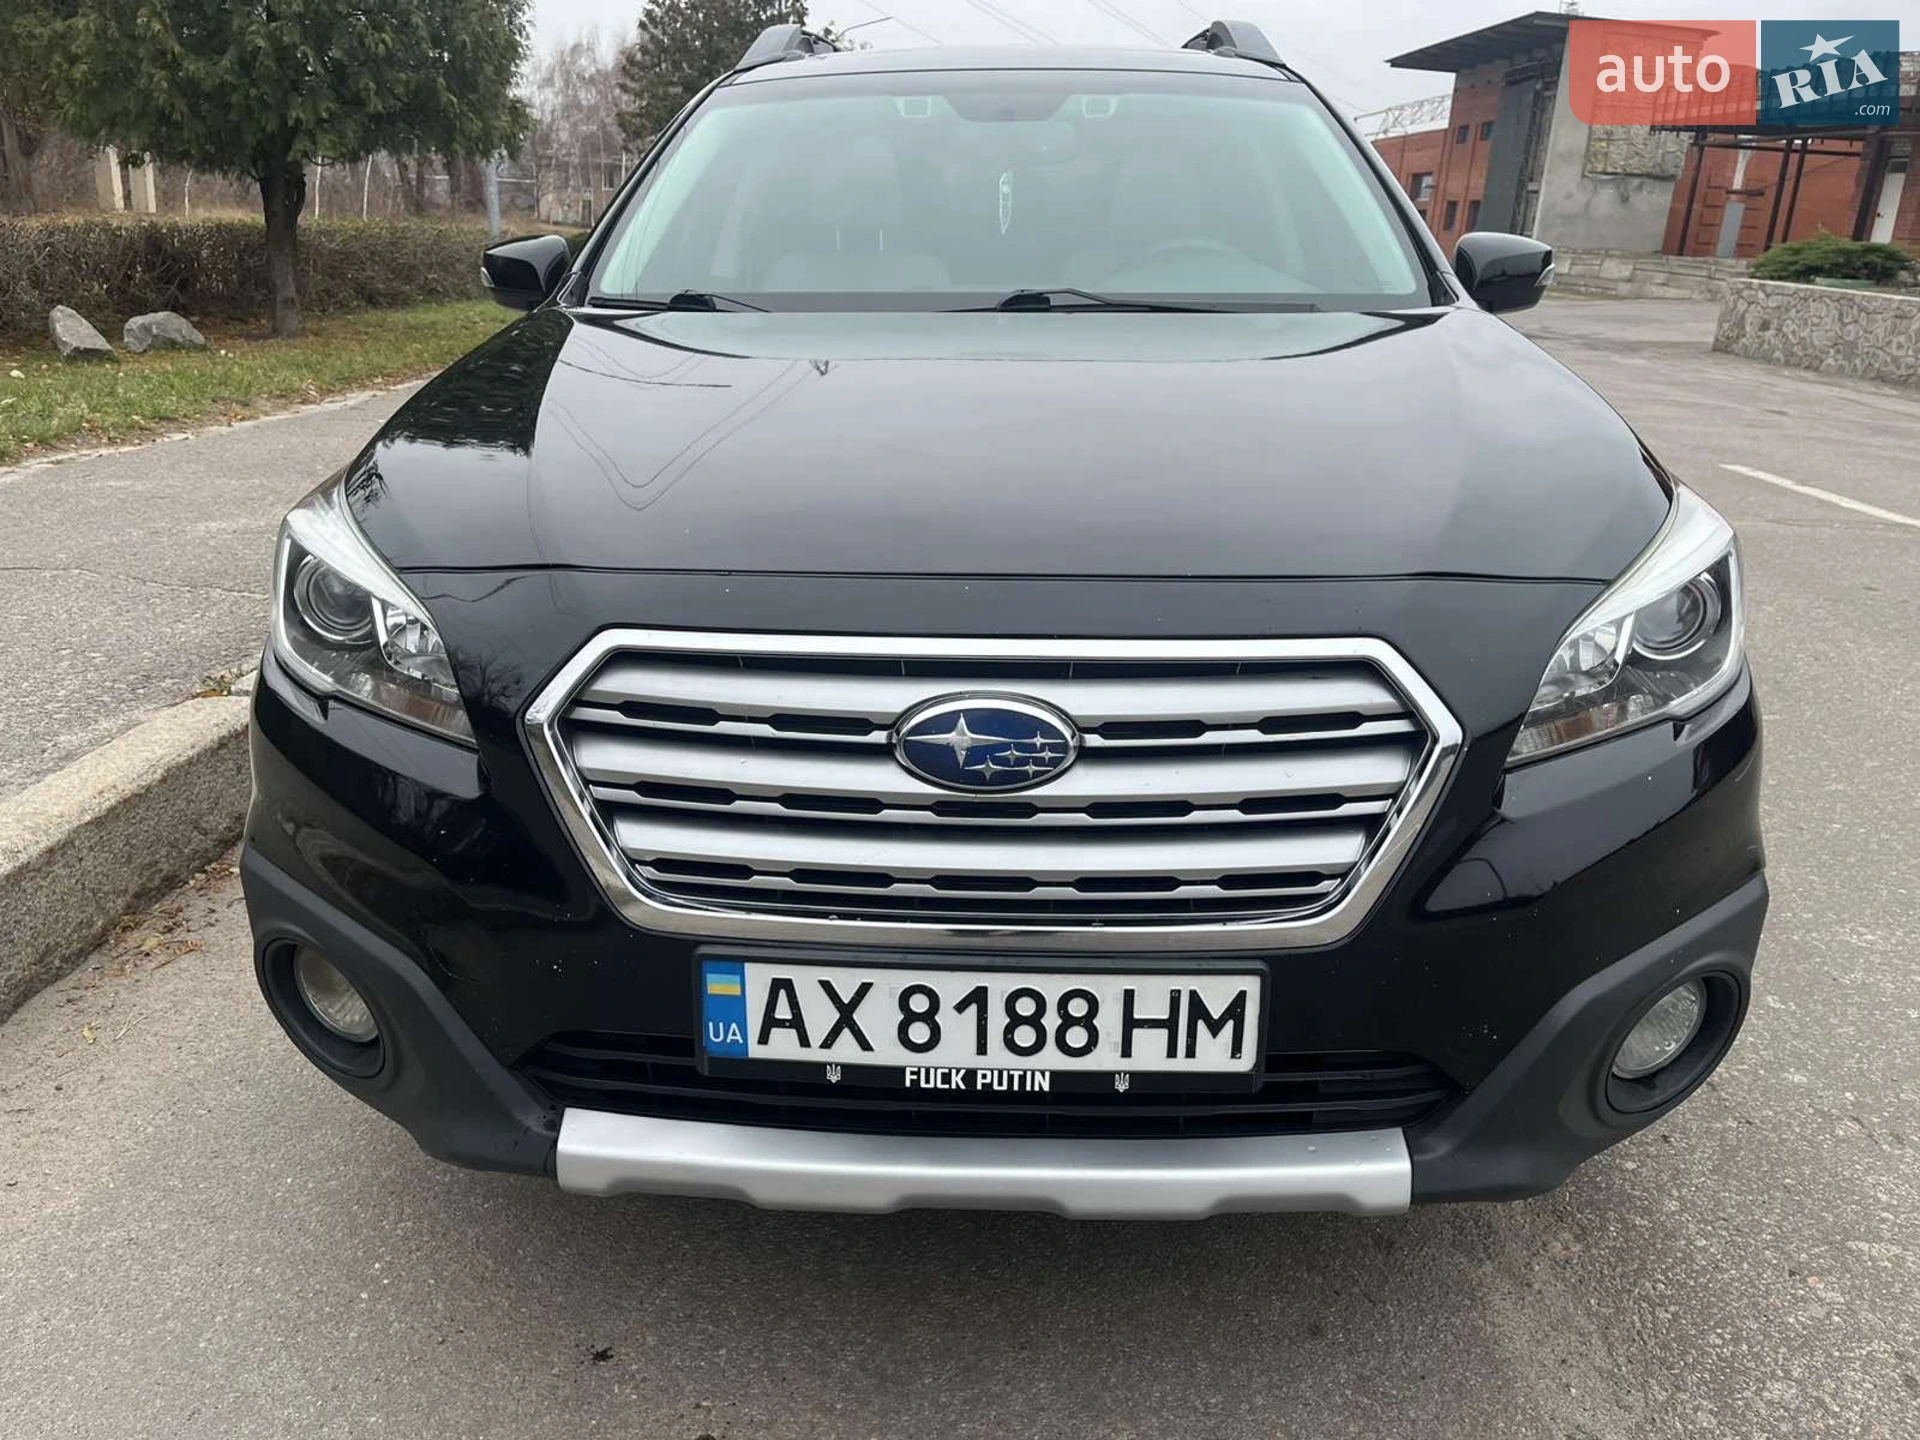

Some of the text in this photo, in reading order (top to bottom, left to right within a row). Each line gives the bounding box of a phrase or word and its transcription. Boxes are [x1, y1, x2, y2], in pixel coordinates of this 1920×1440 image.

[757, 977, 1248, 1060] AX 8188 HM
[709, 1022, 743, 1044] UA
[904, 1066, 1051, 1092] FUCK PUTIN
